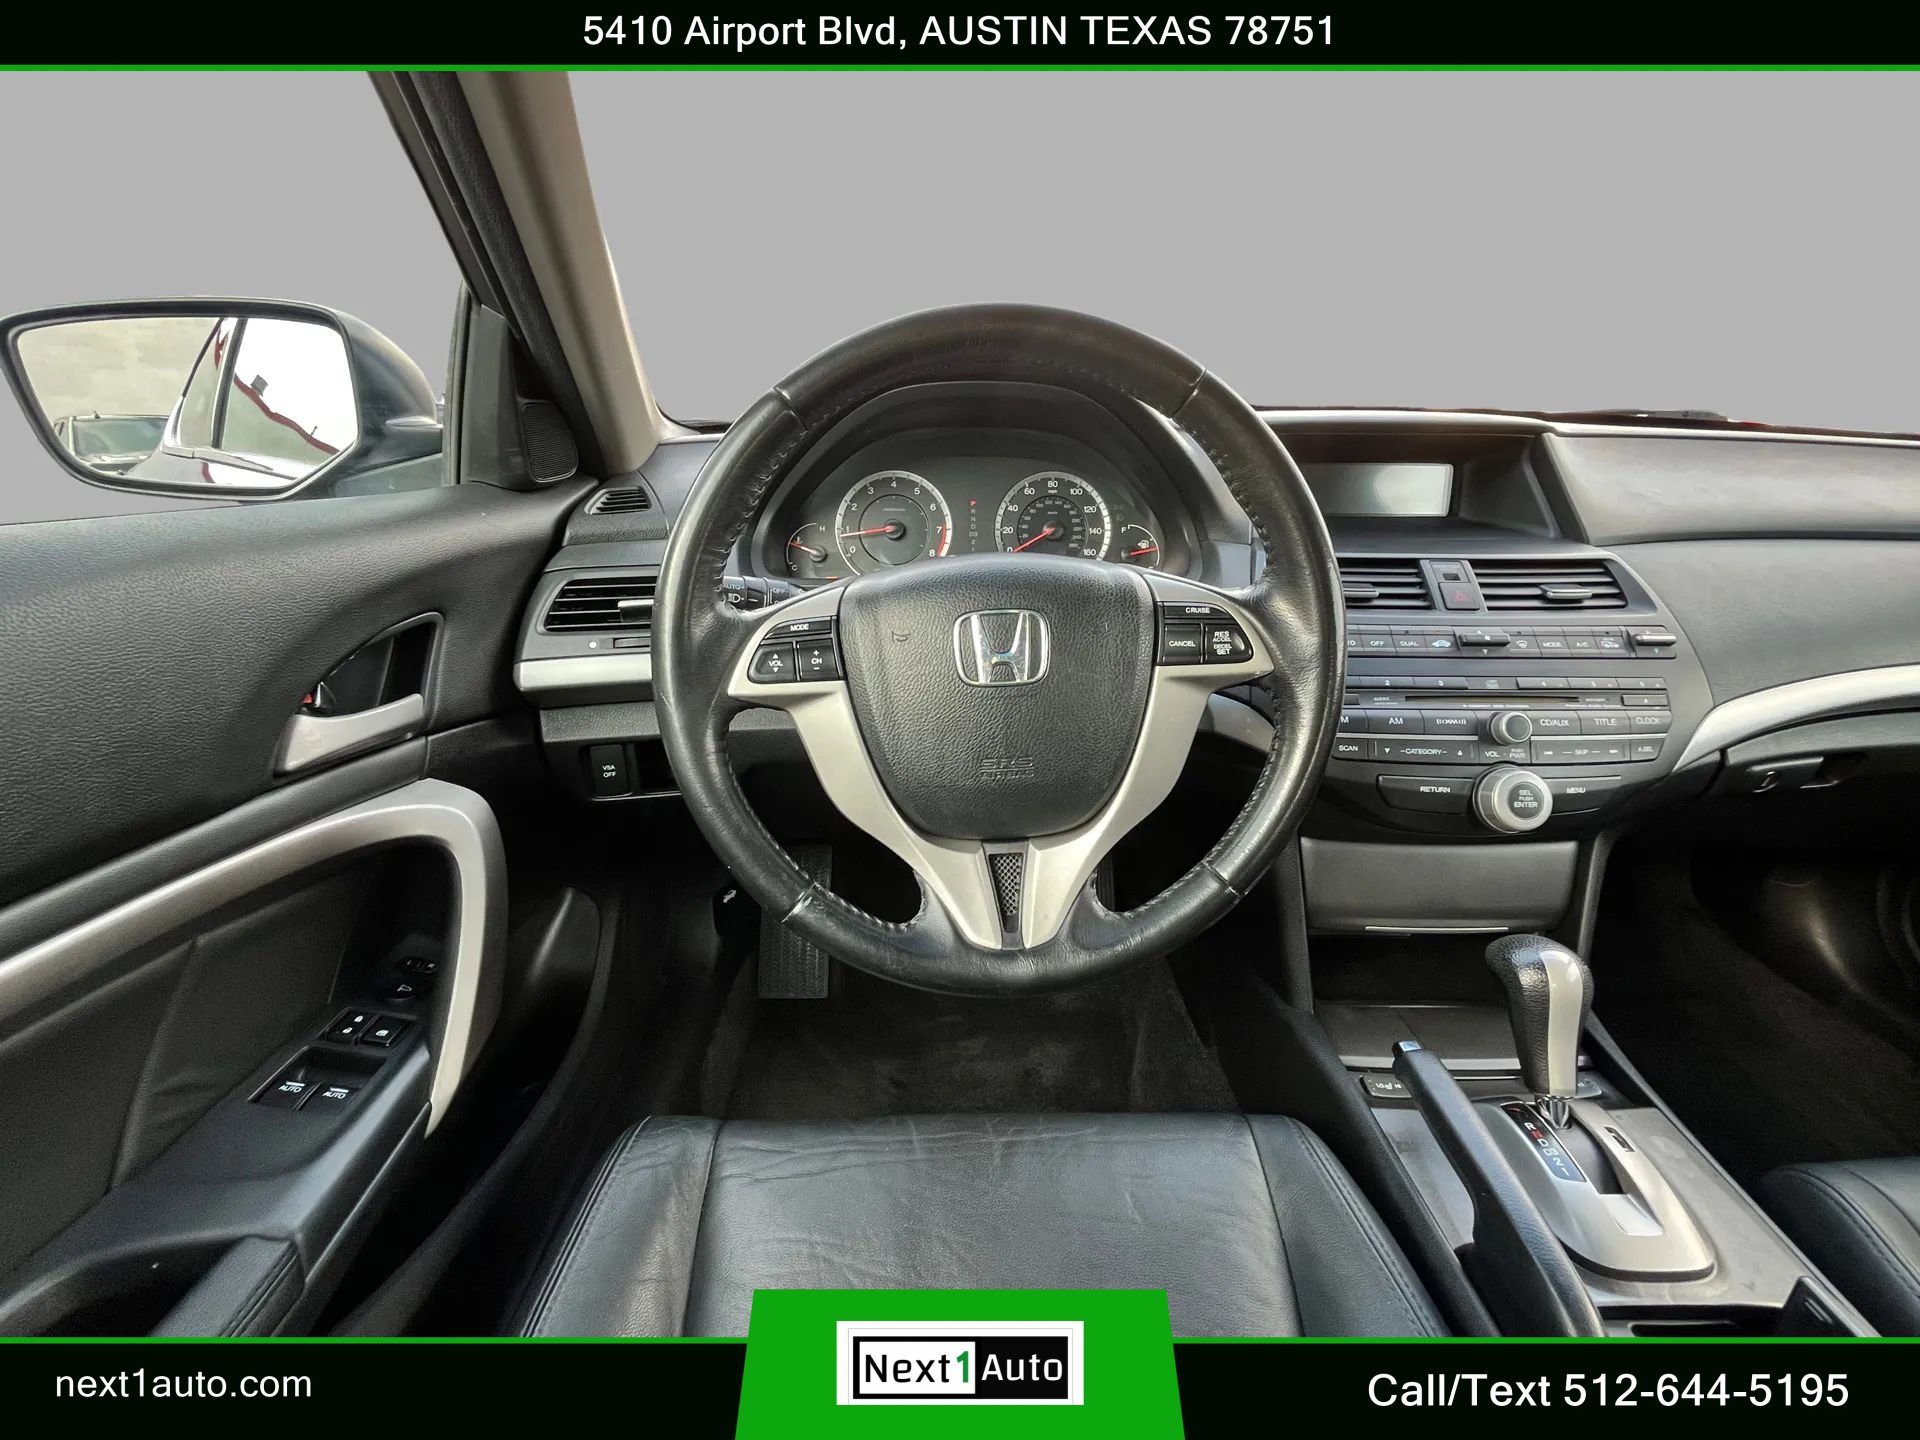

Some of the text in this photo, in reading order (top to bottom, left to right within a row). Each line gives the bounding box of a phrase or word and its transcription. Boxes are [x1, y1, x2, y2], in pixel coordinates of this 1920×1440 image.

[851, 503, 858, 511] 2
[790, 623, 809, 631] MODE
[1388, 717, 1403, 725] AM
[1540, 719, 1570, 727] CD/AUX
[279, 1085, 302, 1093] AUTO
[323, 1091, 346, 1099] AUTO
[1524, 1122, 1537, 1131] R
[1537, 1139, 1549, 1147] D
[1552, 1157, 1565, 1166] 2
